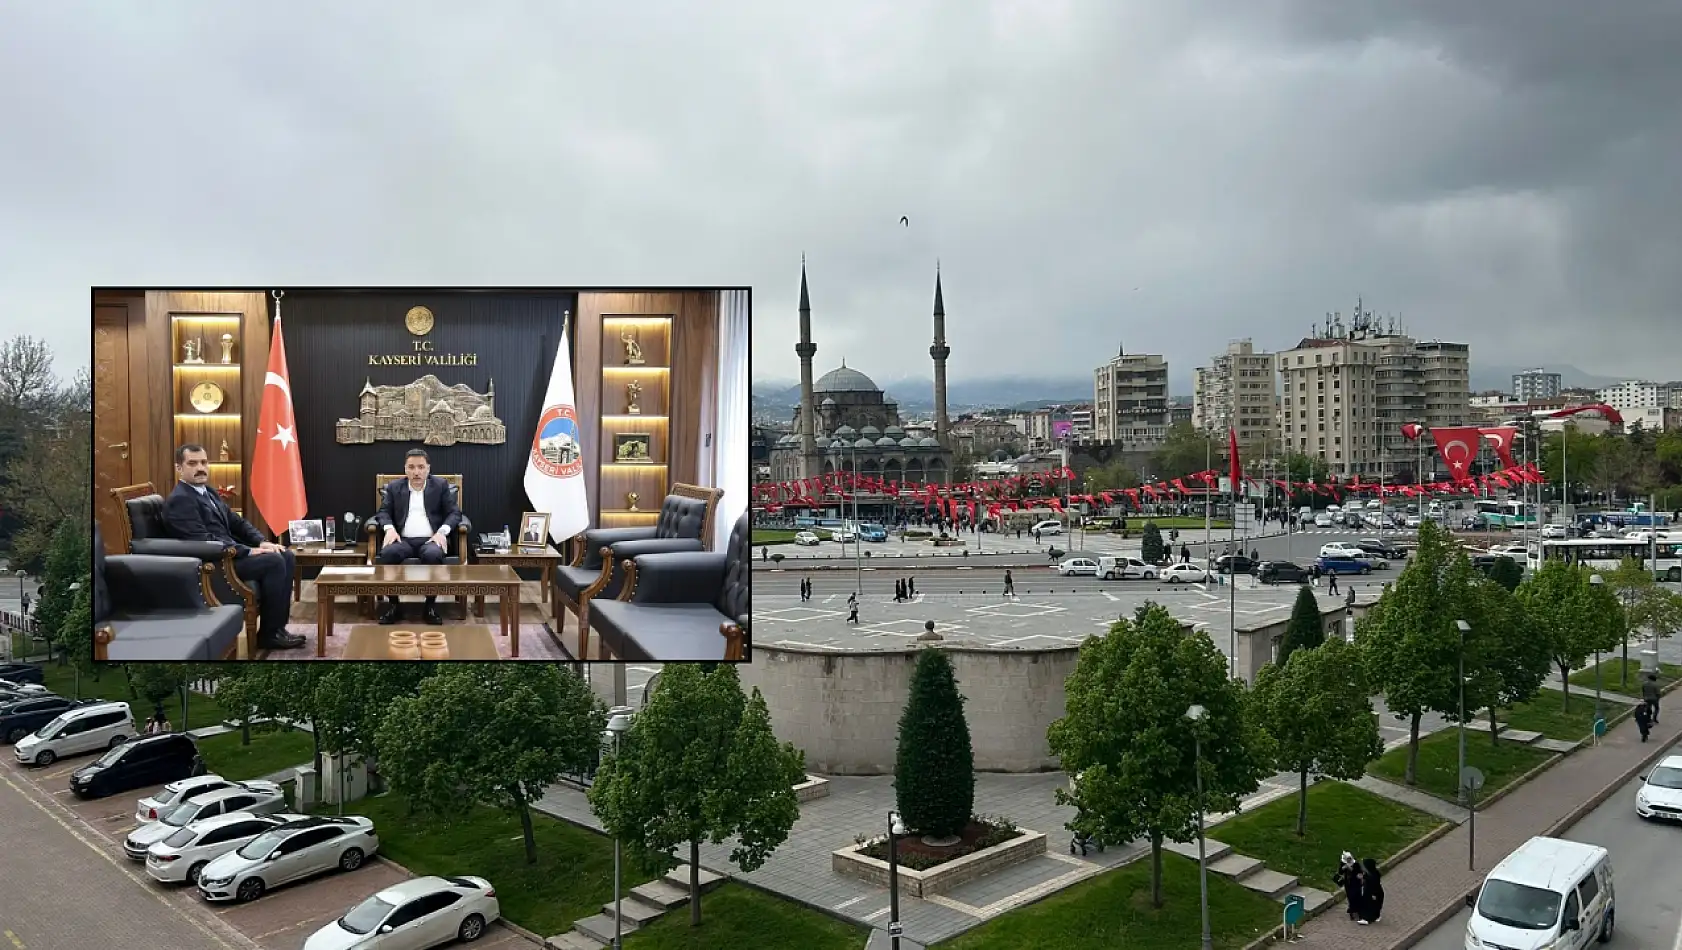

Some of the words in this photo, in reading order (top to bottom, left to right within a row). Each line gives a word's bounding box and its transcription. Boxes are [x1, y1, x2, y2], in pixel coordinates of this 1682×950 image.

[412, 340, 434, 352] T.C.
[368, 353, 422, 366] KAYSERİ
[424, 352, 478, 366] VALİLİĞİ
